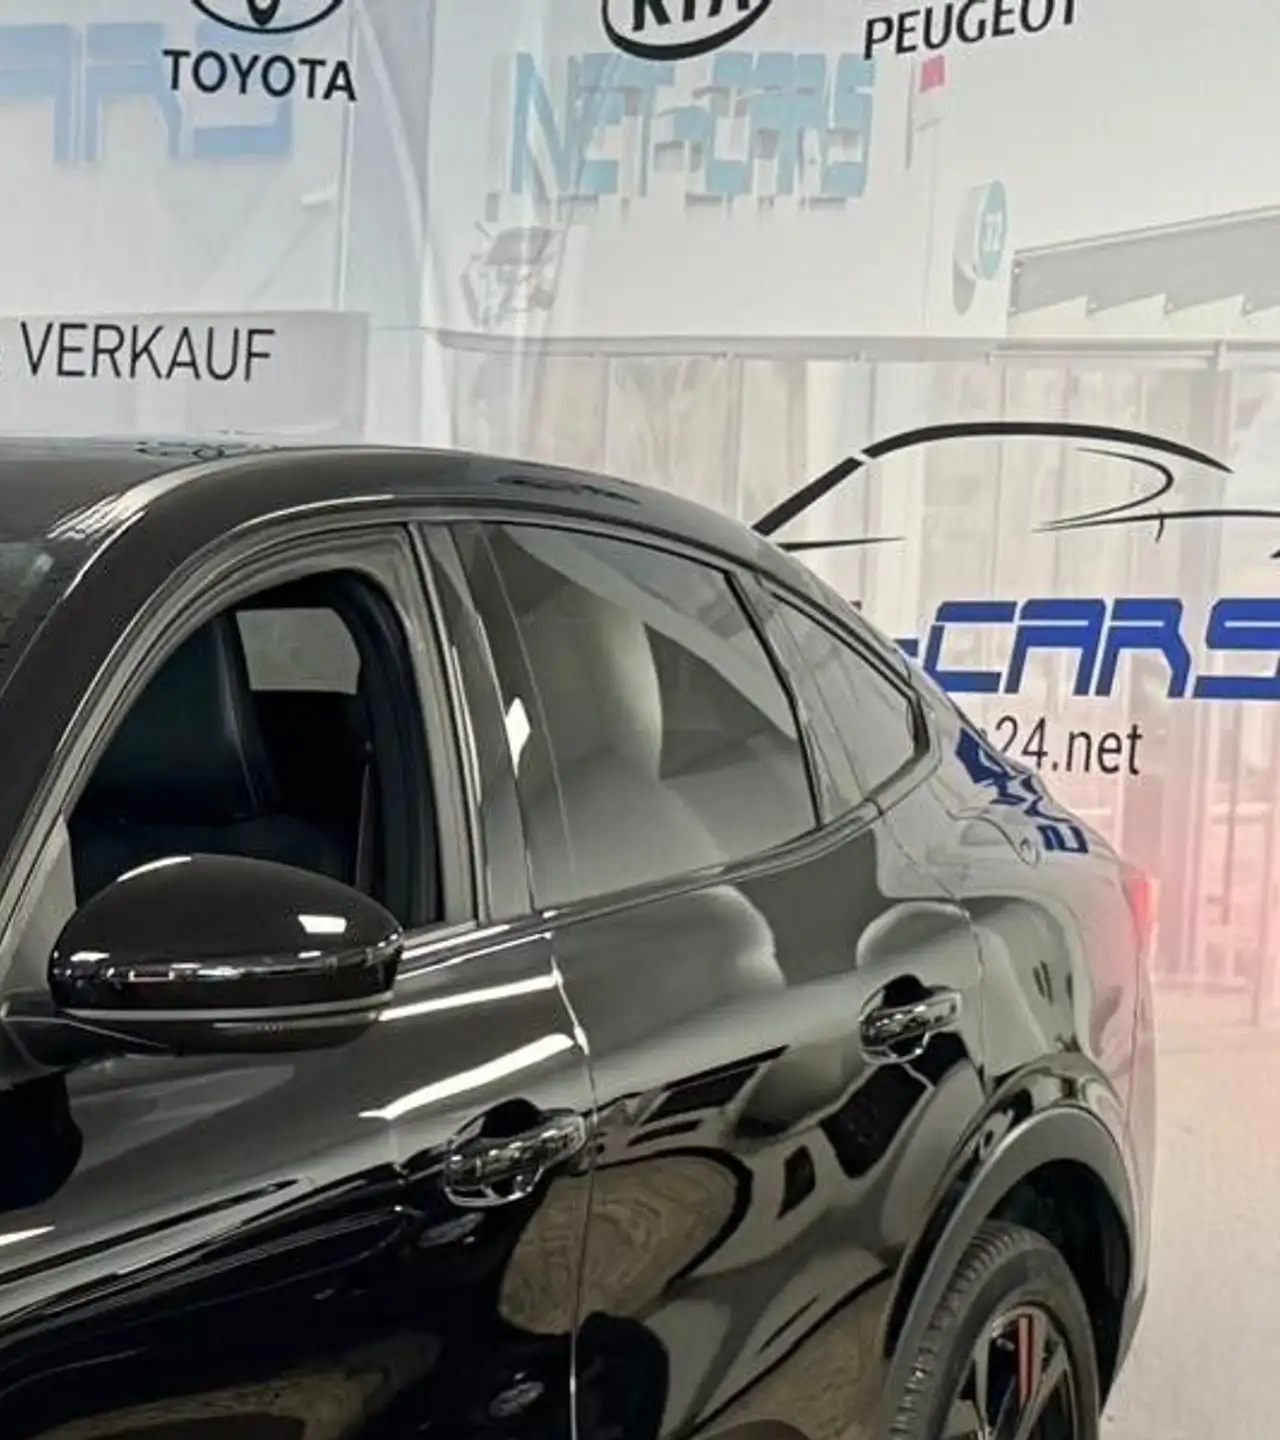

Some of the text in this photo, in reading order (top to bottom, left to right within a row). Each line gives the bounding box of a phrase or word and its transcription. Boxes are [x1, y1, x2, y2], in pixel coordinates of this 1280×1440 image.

[162, 49, 357, 101] TOYOTA
[20, 320, 277, 382] VERKAUF
[978, 715, 1143, 776] 24.net
